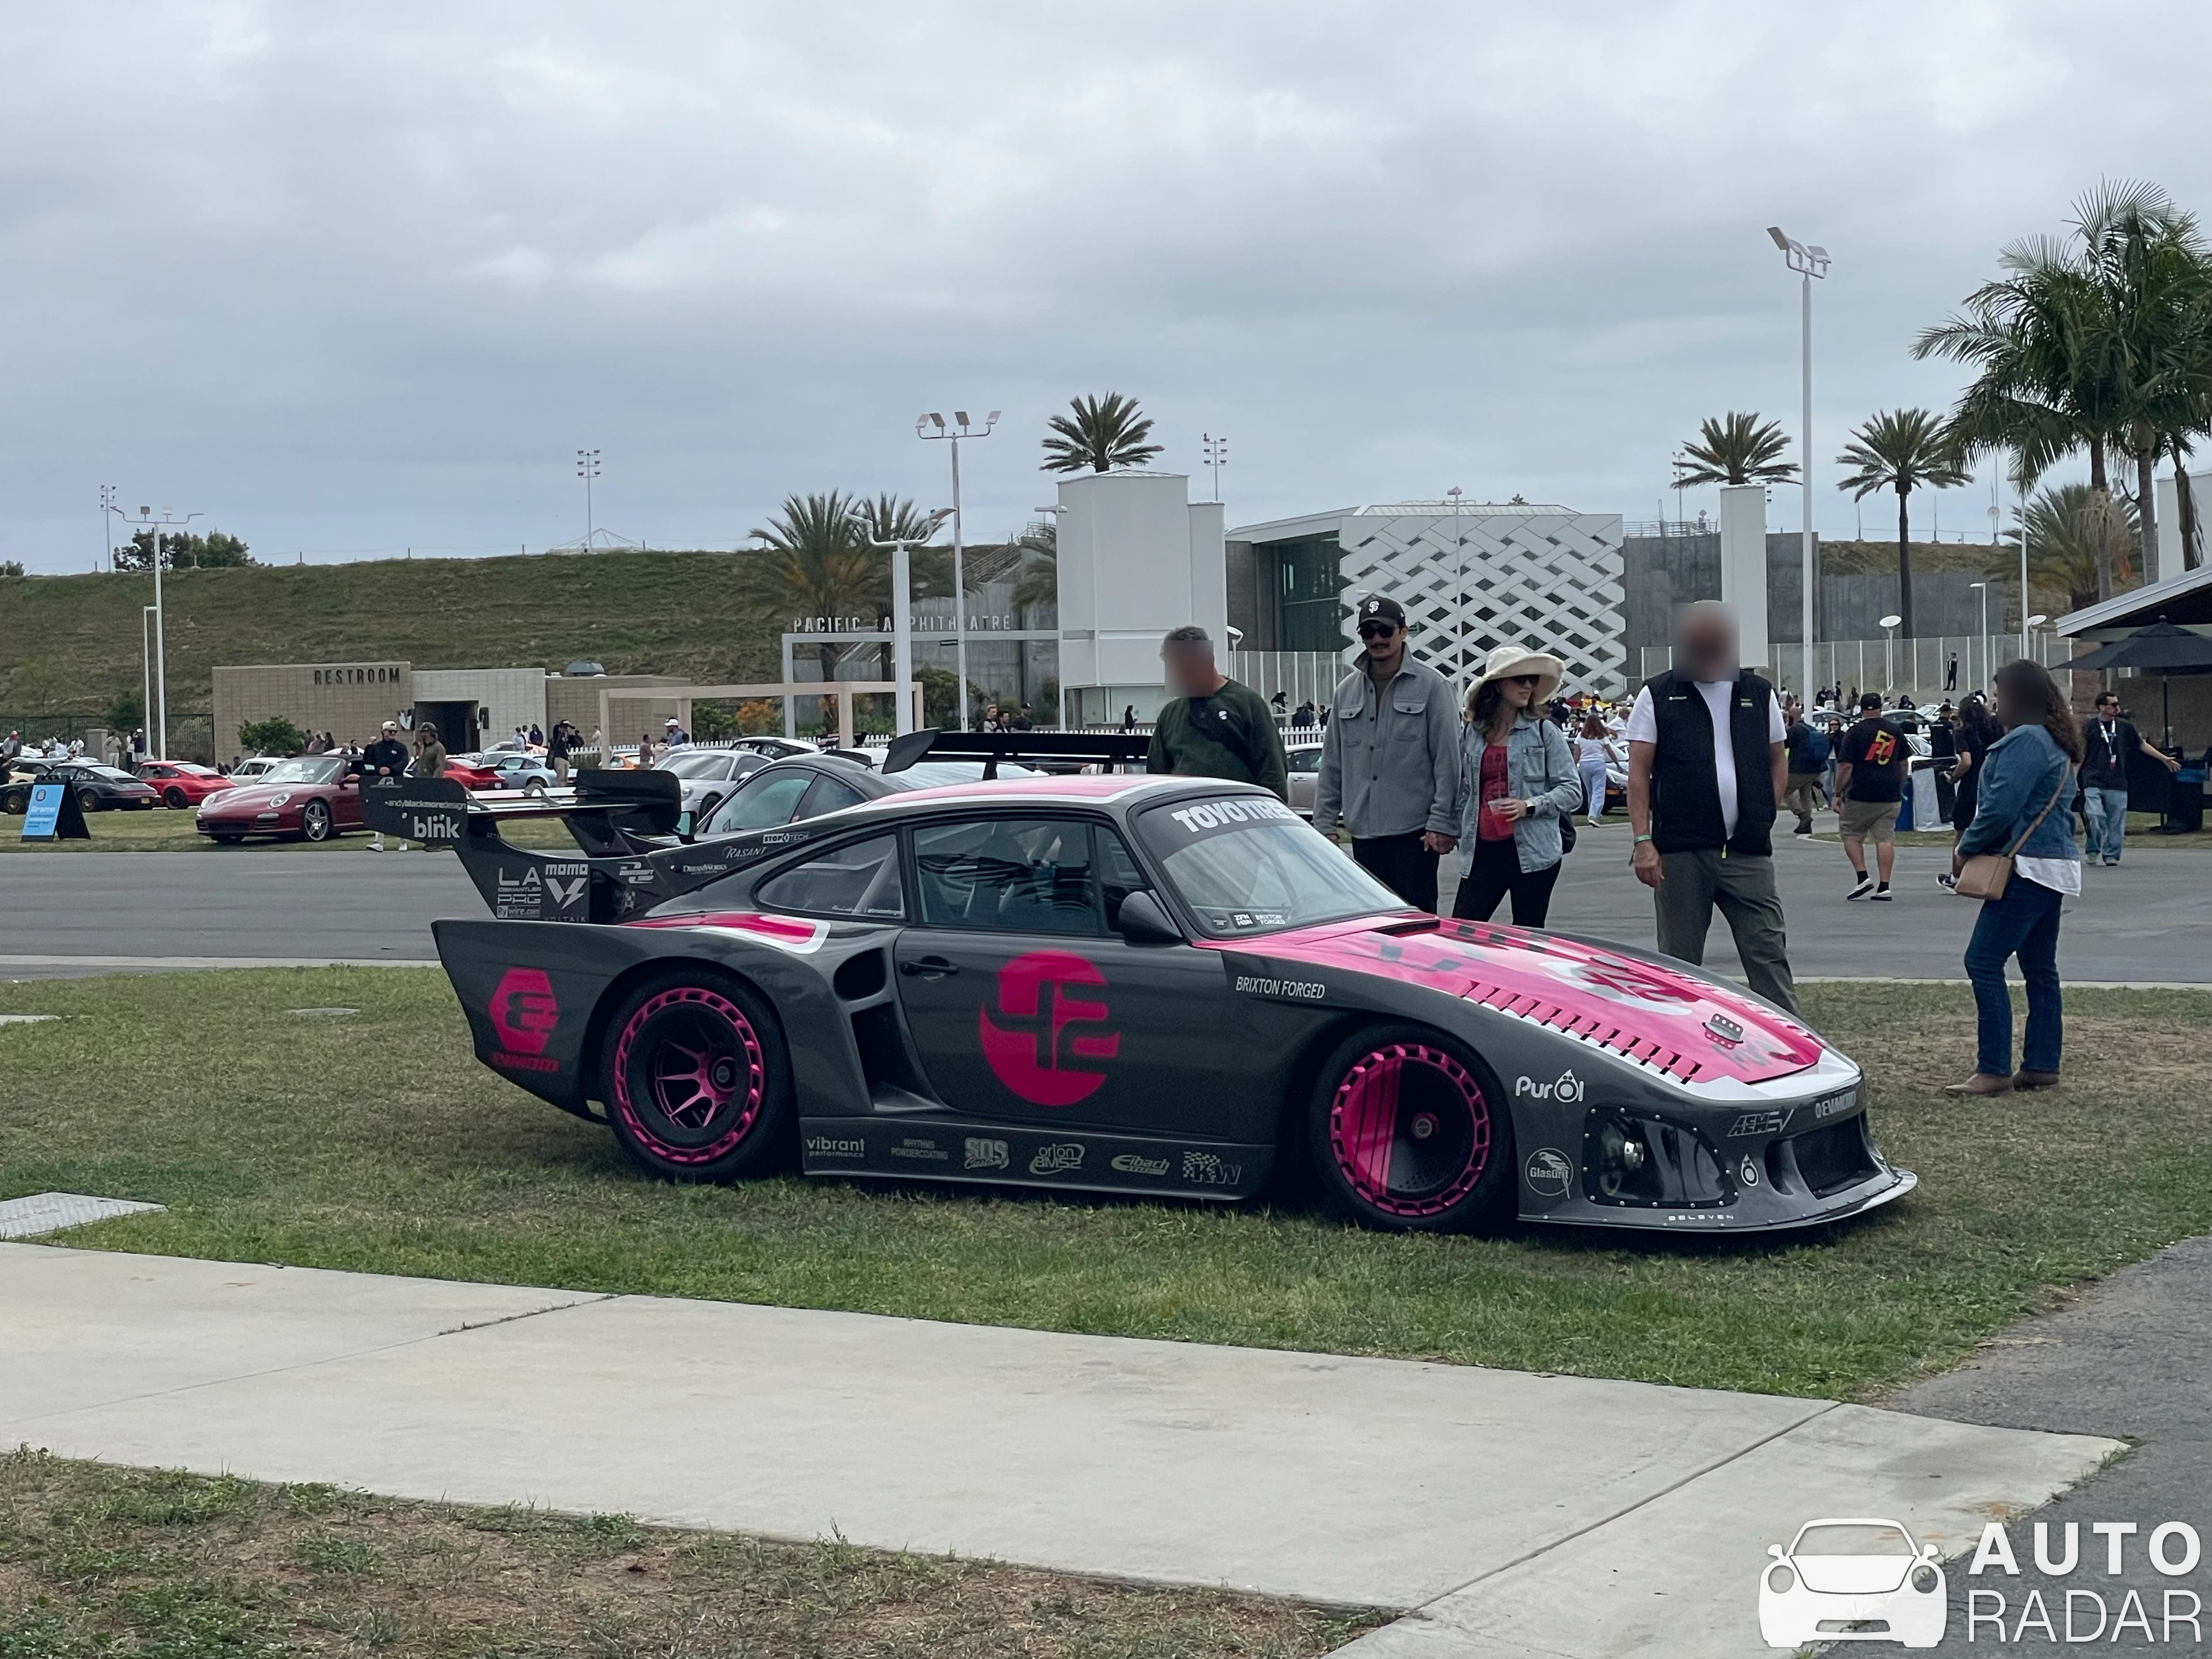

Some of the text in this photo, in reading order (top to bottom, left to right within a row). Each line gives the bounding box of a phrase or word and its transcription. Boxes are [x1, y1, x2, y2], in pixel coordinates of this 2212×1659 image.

[794, 615, 1011, 632] PACIFIC APHITHATRE
[314, 668, 399, 685] RESTROOM
[414, 815, 460, 838] blink
[724, 846, 768, 859] RASANT
[499, 866, 541, 886] LA
[498, 893, 541, 904] PAG
[1235, 976, 1325, 999] BRIXTON FORGED
[805, 1136, 865, 1152] vibrant
[964, 1137, 1008, 1159] SOS
[1039, 1143, 1074, 1159] orion
[890, 1147, 949, 1160] POWDERCOATING
[1111, 1154, 1170, 1173] Eibach
[1193, 1161, 1242, 1185] KW
